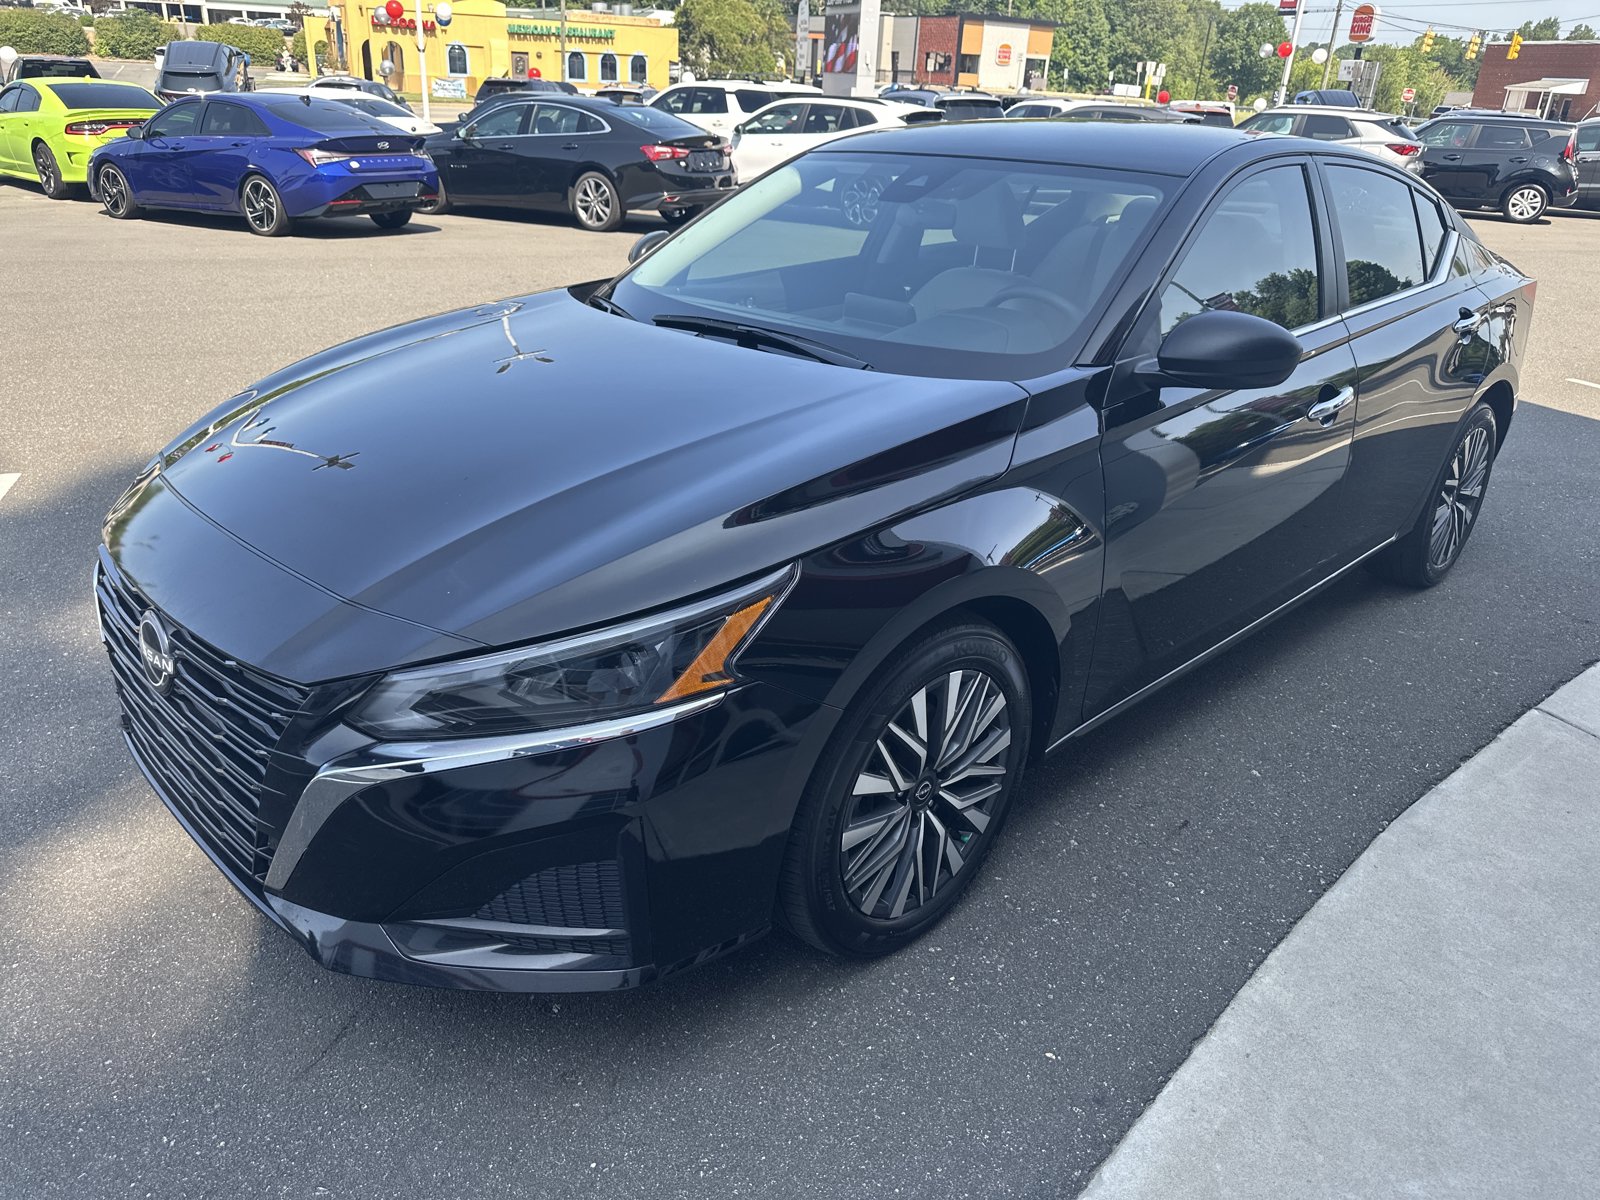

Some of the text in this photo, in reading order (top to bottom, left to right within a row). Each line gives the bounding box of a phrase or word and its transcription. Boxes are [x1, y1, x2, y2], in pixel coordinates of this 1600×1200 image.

[390, 17, 436, 30] COCNA
[1352, 15, 1374, 24] BURGER
[555, 27, 616, 39] RSTAURANT
[1350, 23, 1372, 34] KING
